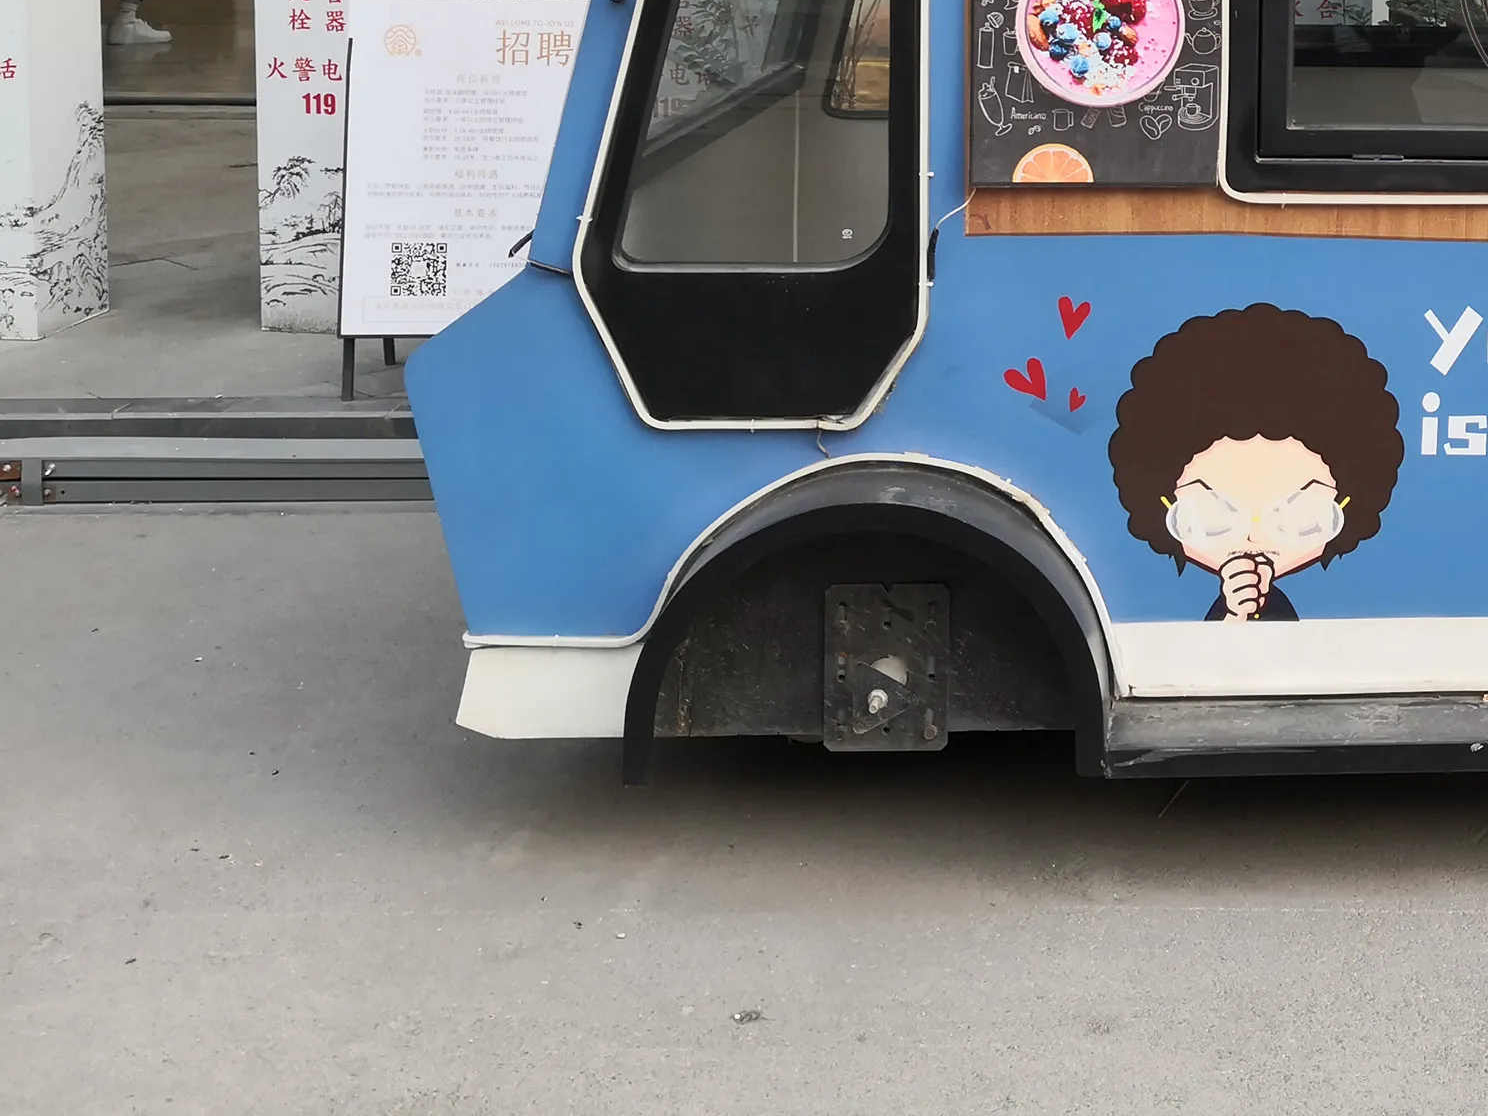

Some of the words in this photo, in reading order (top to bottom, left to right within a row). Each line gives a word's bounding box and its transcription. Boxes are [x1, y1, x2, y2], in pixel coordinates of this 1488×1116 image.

[495, 29, 574, 67] 招聘
[266, 56, 344, 83] 火警电
[302, 92, 337, 116] 119
[1010, 106, 1047, 121] Americano
[1138, 101, 1174, 114] Cappuccino
[1421, 391, 1488, 457] is
